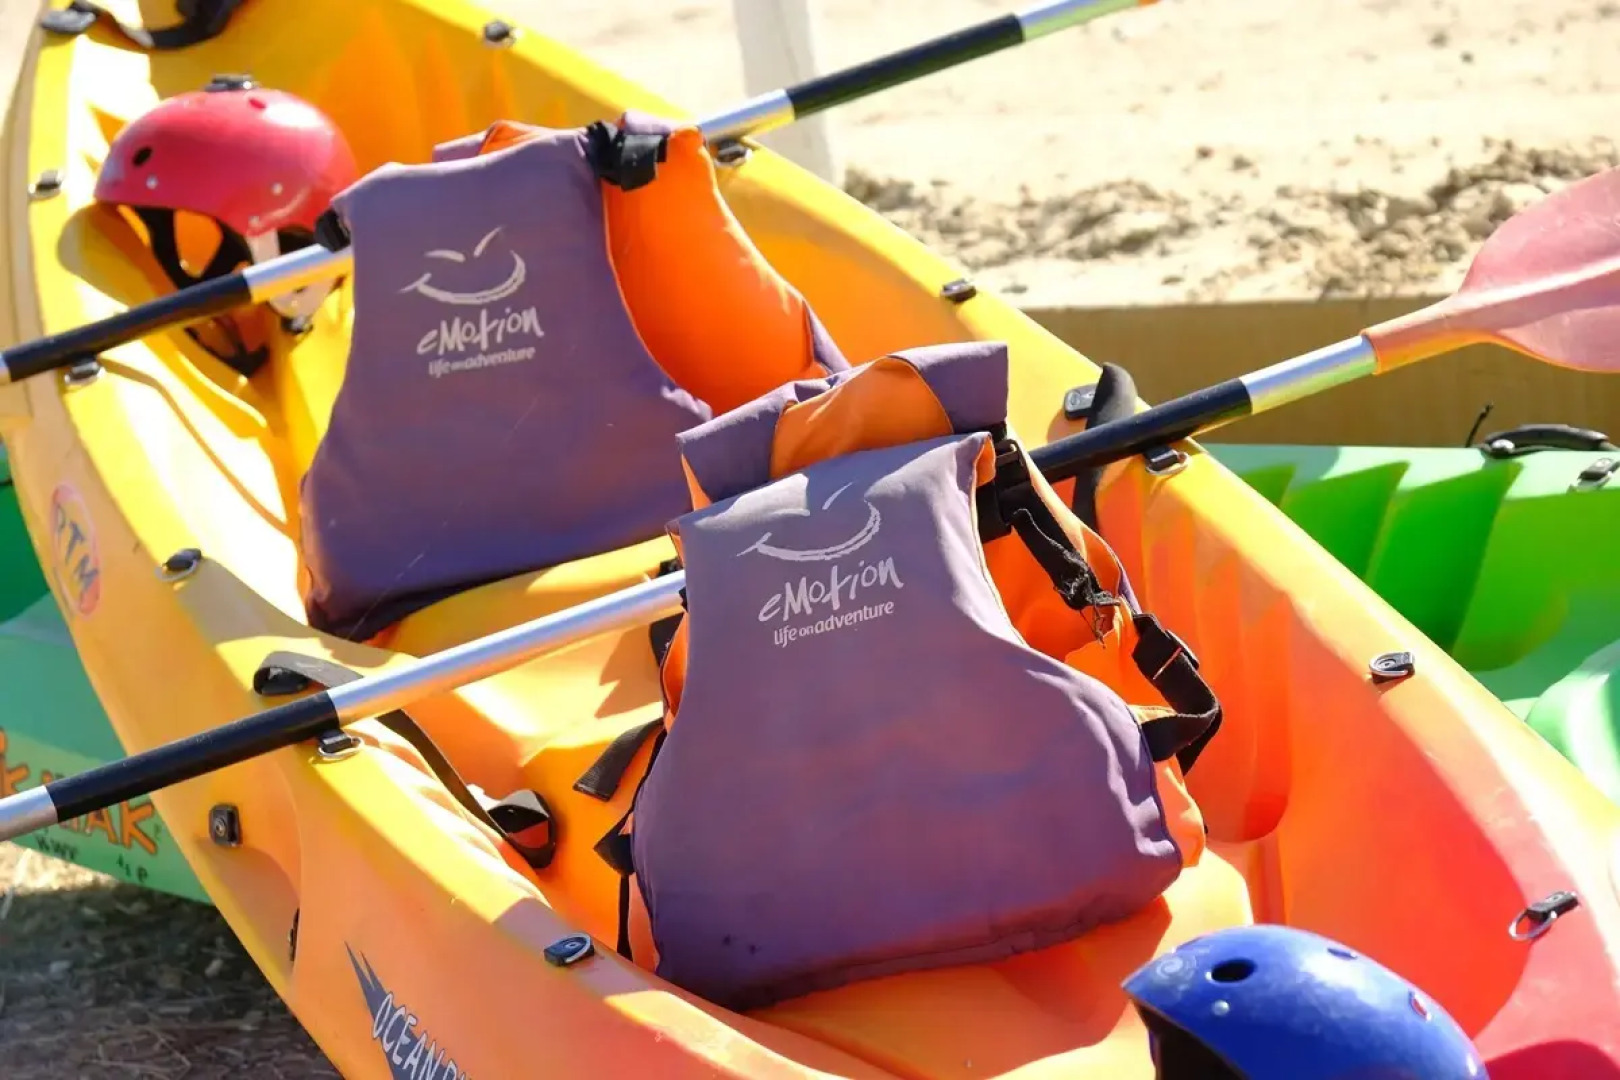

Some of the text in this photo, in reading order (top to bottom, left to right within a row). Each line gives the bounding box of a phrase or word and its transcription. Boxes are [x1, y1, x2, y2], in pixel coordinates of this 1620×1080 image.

[428, 357, 450, 378] life
[464, 347, 536, 369] adventure
[758, 557, 904, 621] eMotion
[774, 601, 894, 648] life on adventure
[372, 992, 445, 1080] OCEAN
